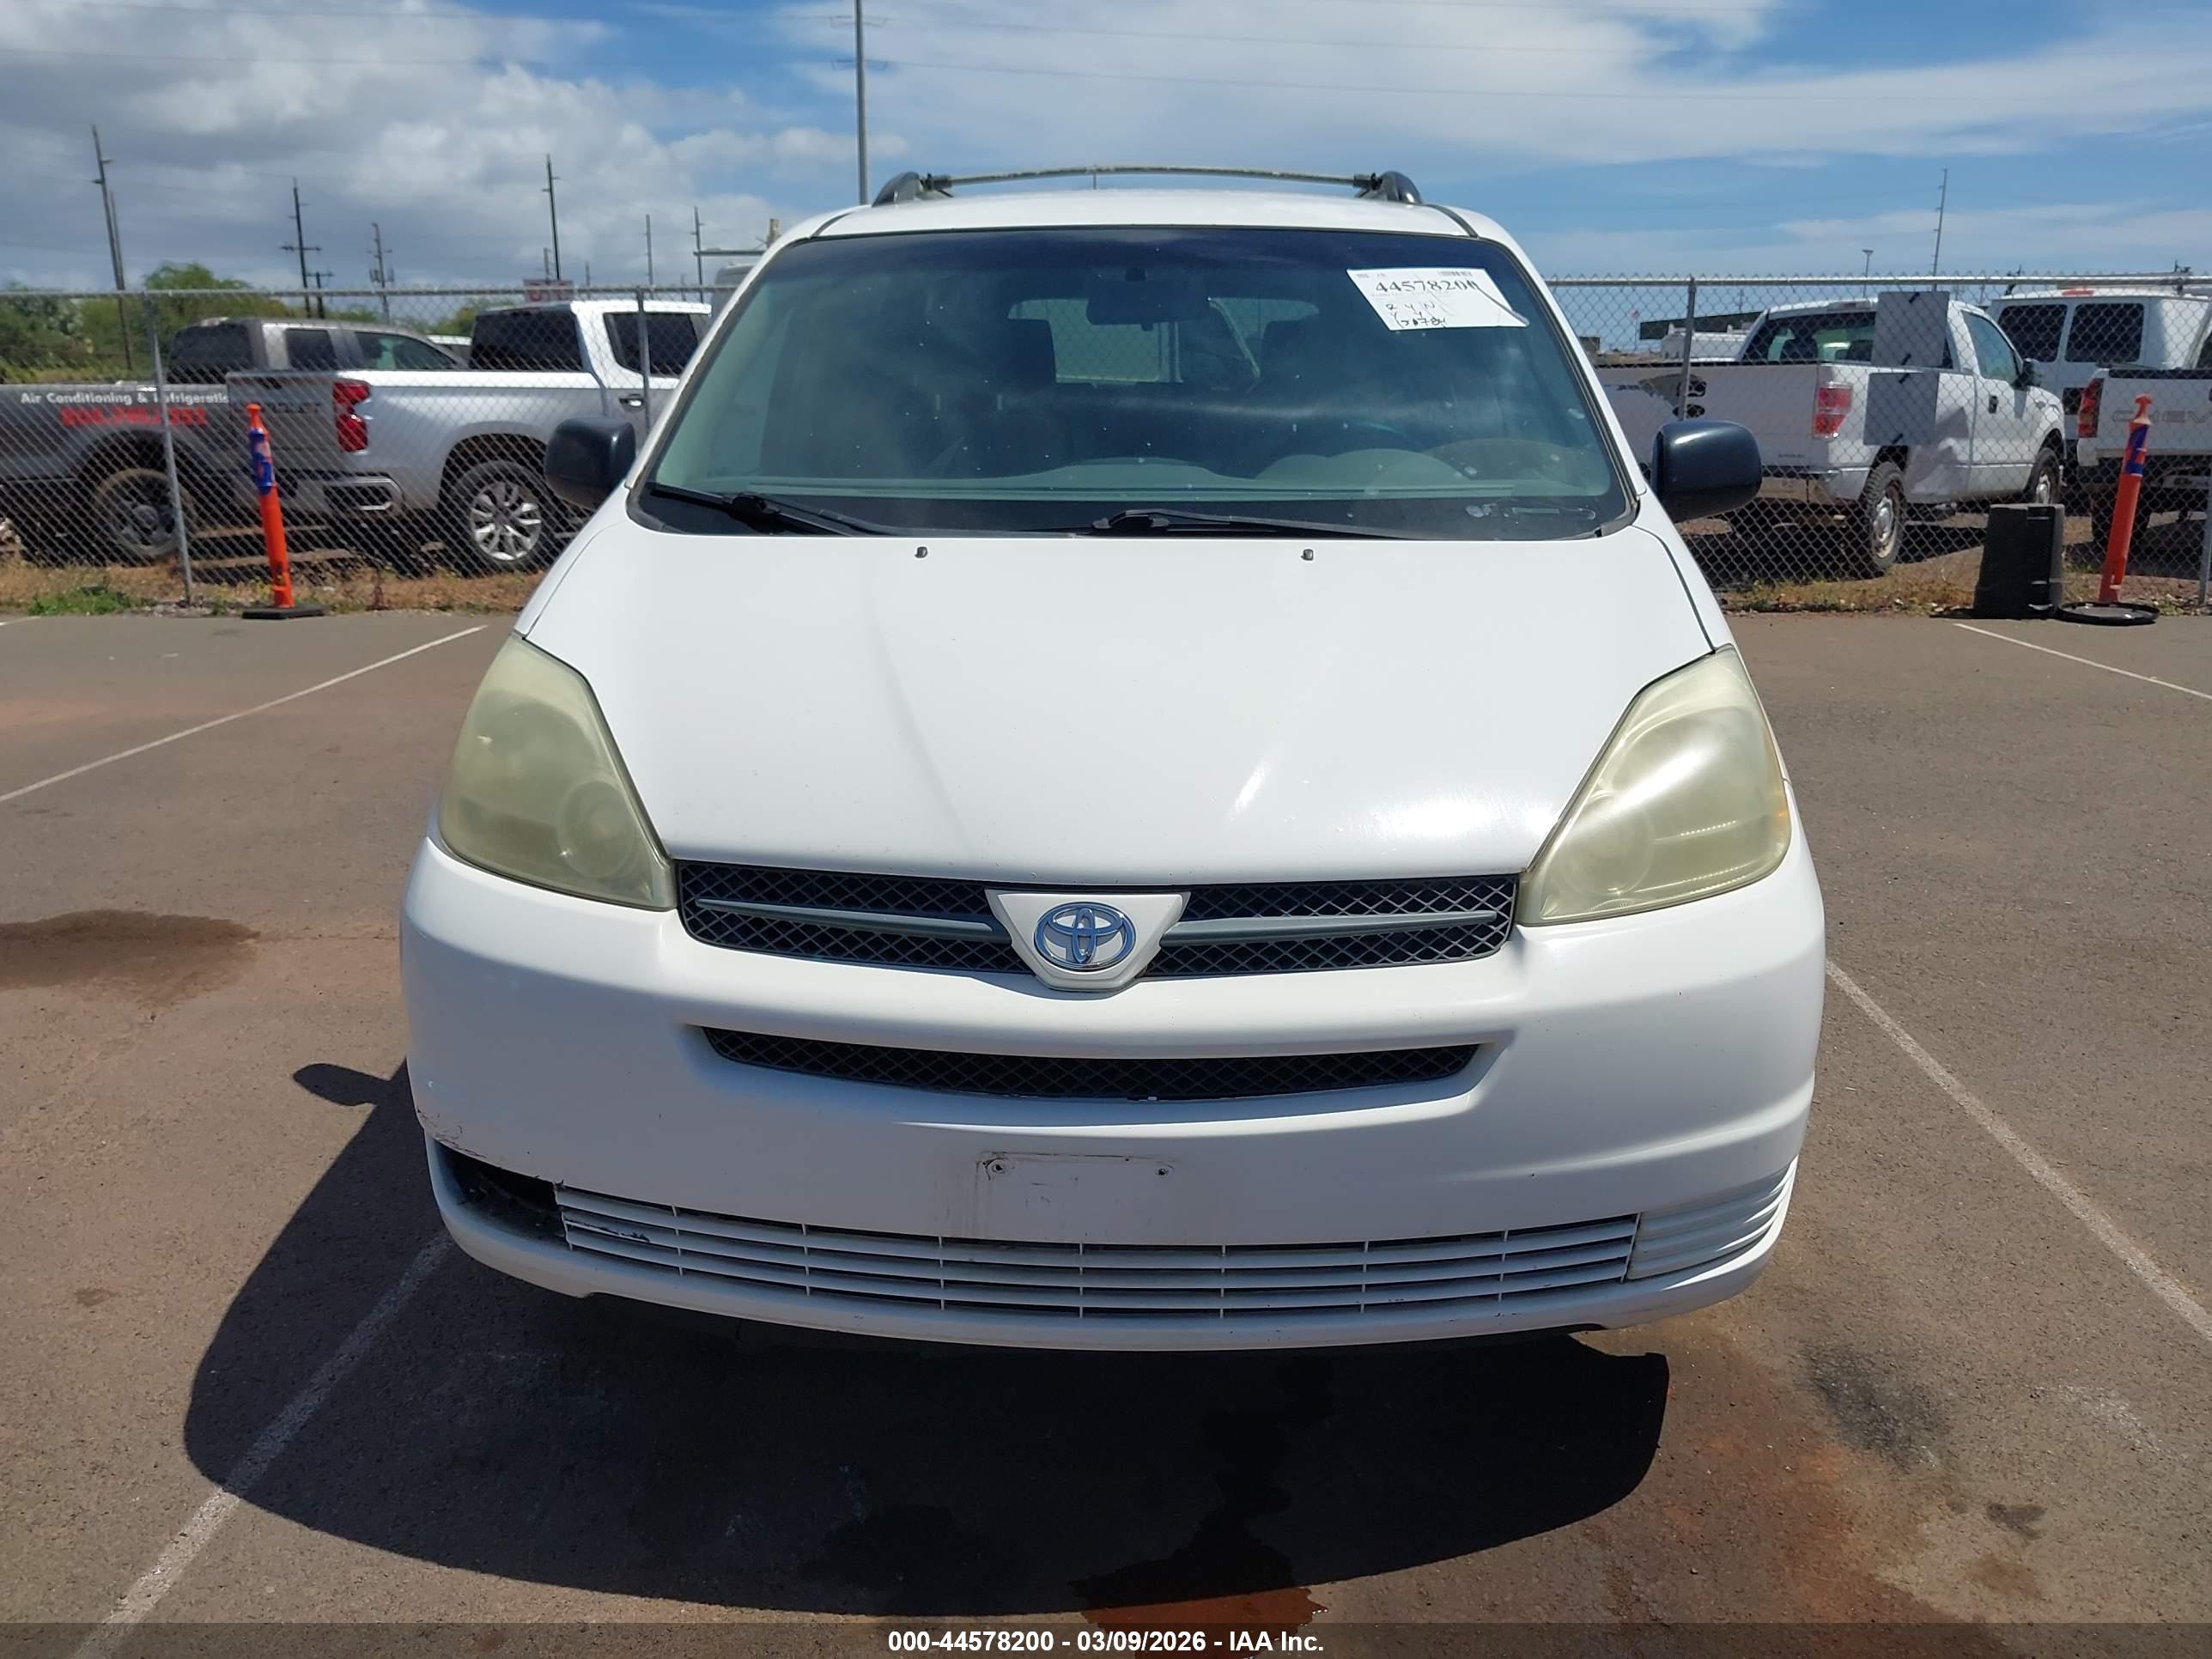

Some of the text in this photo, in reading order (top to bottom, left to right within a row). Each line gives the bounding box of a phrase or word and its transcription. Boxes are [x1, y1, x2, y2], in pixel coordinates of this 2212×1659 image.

[21, 392, 41, 404] Air
[46, 392, 132, 406] Conditioning
[137, 392, 148, 404] &
